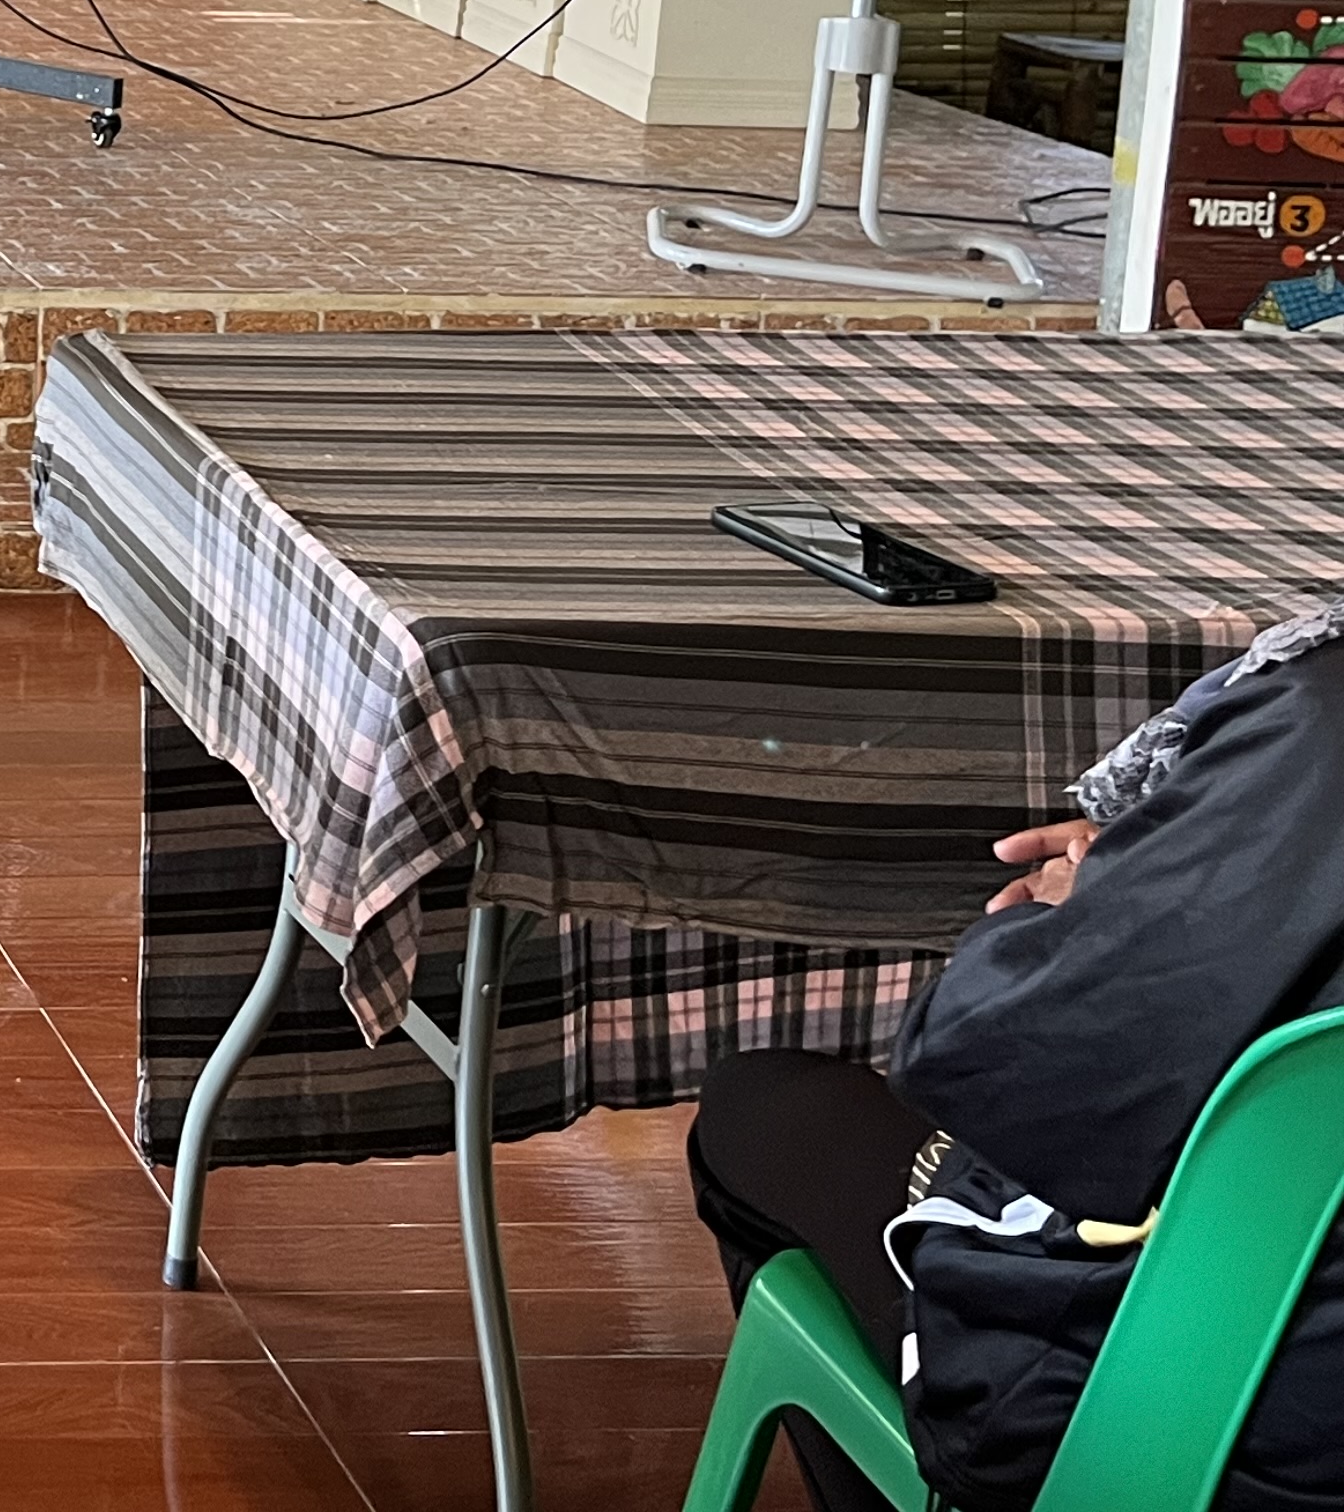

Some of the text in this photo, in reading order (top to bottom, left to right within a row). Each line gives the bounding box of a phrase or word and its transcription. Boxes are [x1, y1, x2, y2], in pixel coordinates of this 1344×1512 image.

[1188, 190, 1312, 239] พออยู่ 3
